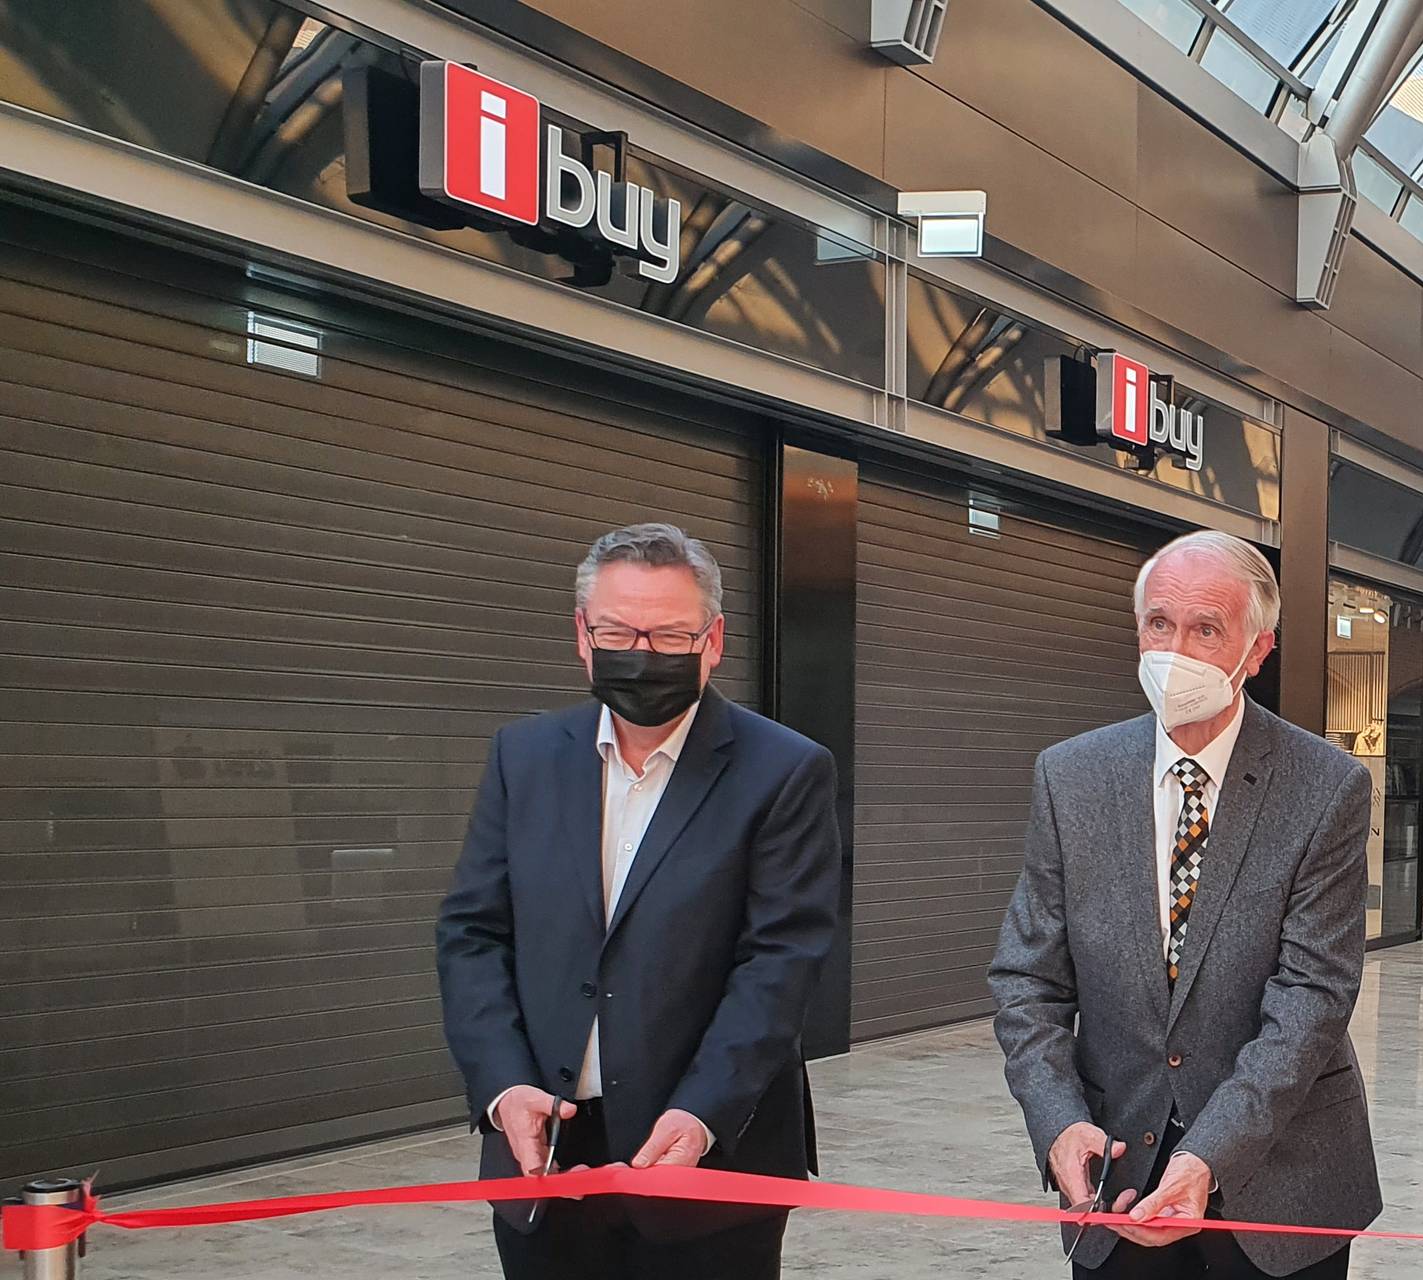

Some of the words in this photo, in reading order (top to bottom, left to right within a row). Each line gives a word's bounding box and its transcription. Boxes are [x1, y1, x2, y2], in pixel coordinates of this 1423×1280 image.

[480, 90, 506, 200] i
[546, 124, 681, 284] buy
[1125, 367, 1137, 433] i
[1149, 381, 1203, 471] buy
